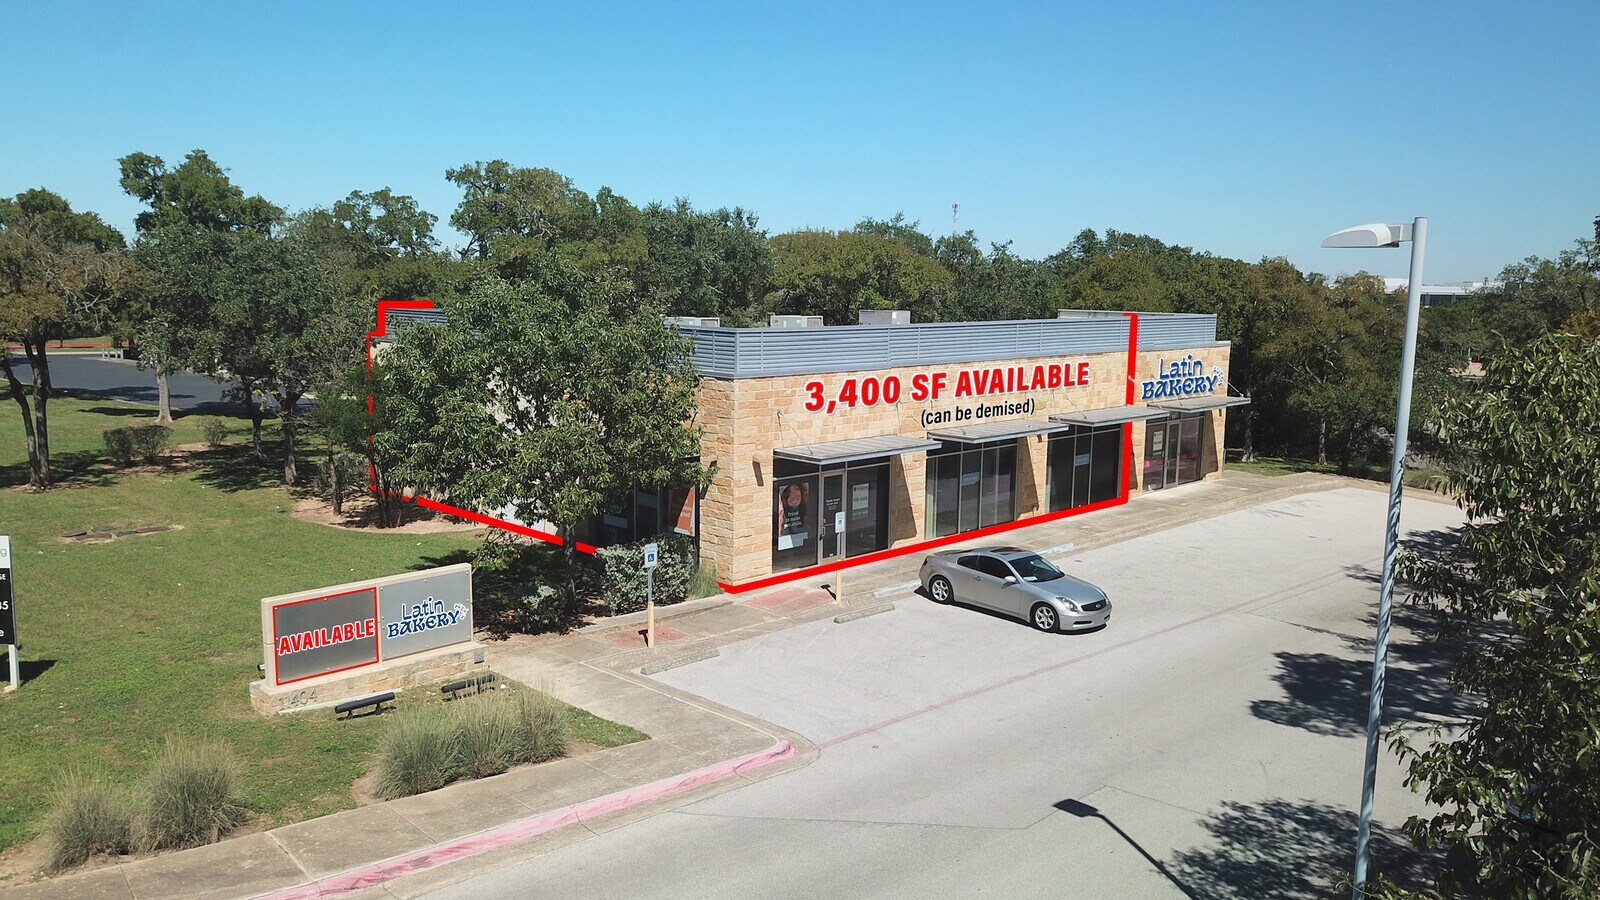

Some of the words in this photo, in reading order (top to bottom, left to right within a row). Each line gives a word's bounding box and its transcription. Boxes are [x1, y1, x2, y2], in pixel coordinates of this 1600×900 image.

[1160, 354, 1203, 380] Latin
[1141, 375, 1218, 400] BAKERY
[402, 597, 443, 621] Latin
[387, 610, 460, 638] BAKERY
